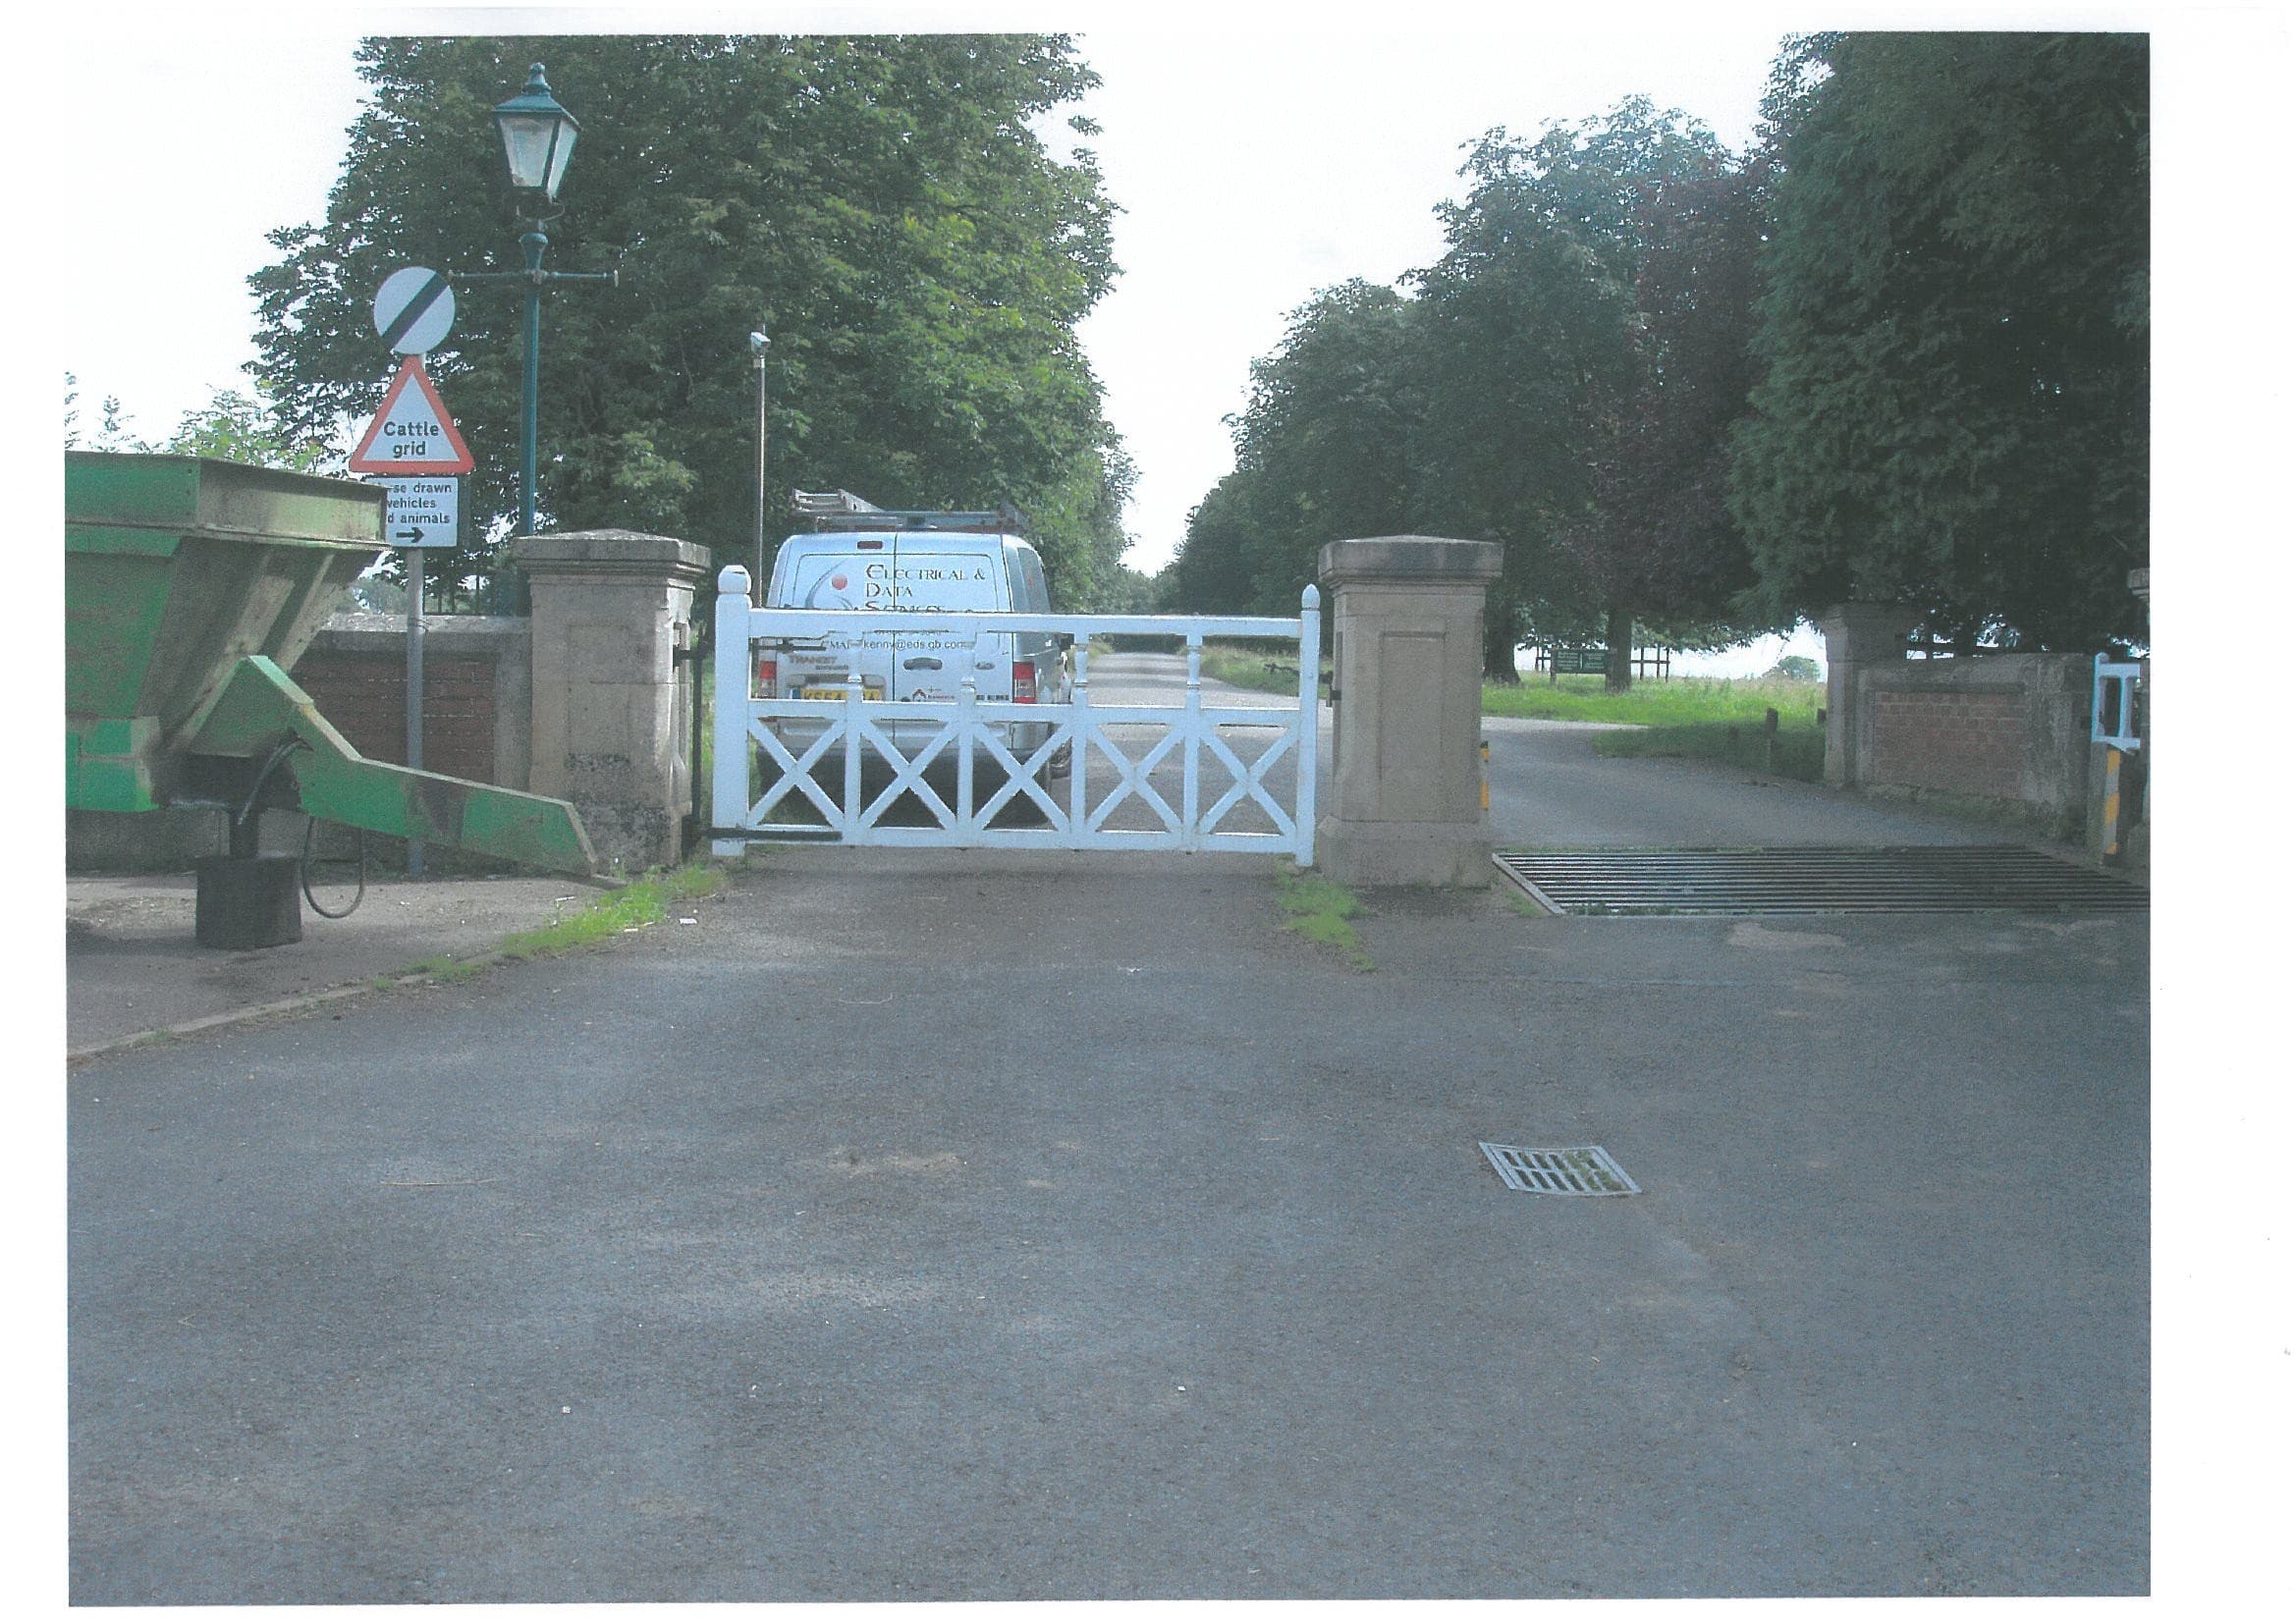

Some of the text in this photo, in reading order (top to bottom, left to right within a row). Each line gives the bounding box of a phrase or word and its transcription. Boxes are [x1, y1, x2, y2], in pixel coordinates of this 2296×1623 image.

[384, 421, 439, 436] Cattle
[393, 441, 426, 459] grid
[412, 482, 453, 493] drawn
[387, 497, 437, 509] vehicles
[400, 513, 451, 523] animals
[865, 564, 986, 580] ELECTRICAL &
[865, 582, 913, 598] DATA
